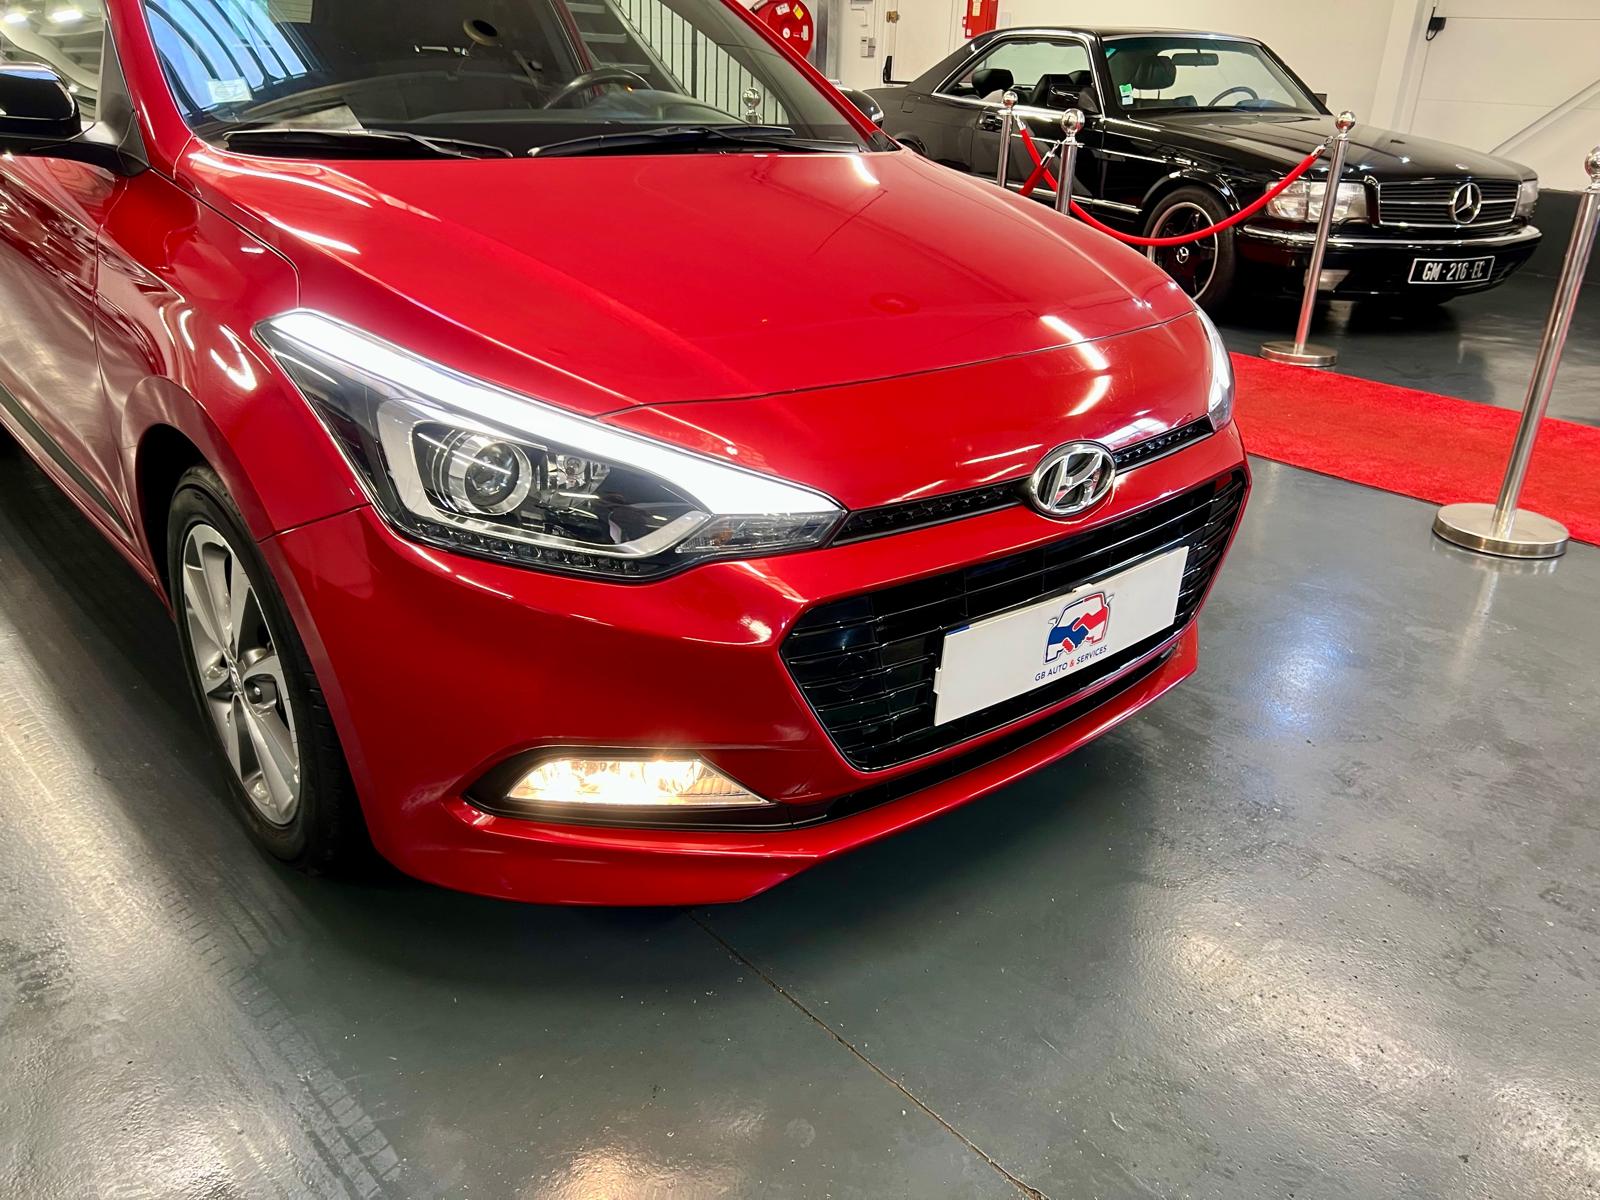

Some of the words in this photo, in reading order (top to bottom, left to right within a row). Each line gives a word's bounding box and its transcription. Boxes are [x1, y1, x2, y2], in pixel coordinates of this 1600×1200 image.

[1035, 672, 1046, 681] GB
[1047, 663, 1068, 676] AUTO
[1069, 660, 1075, 668] &
[1076, 645, 1107, 664] SERVICES
